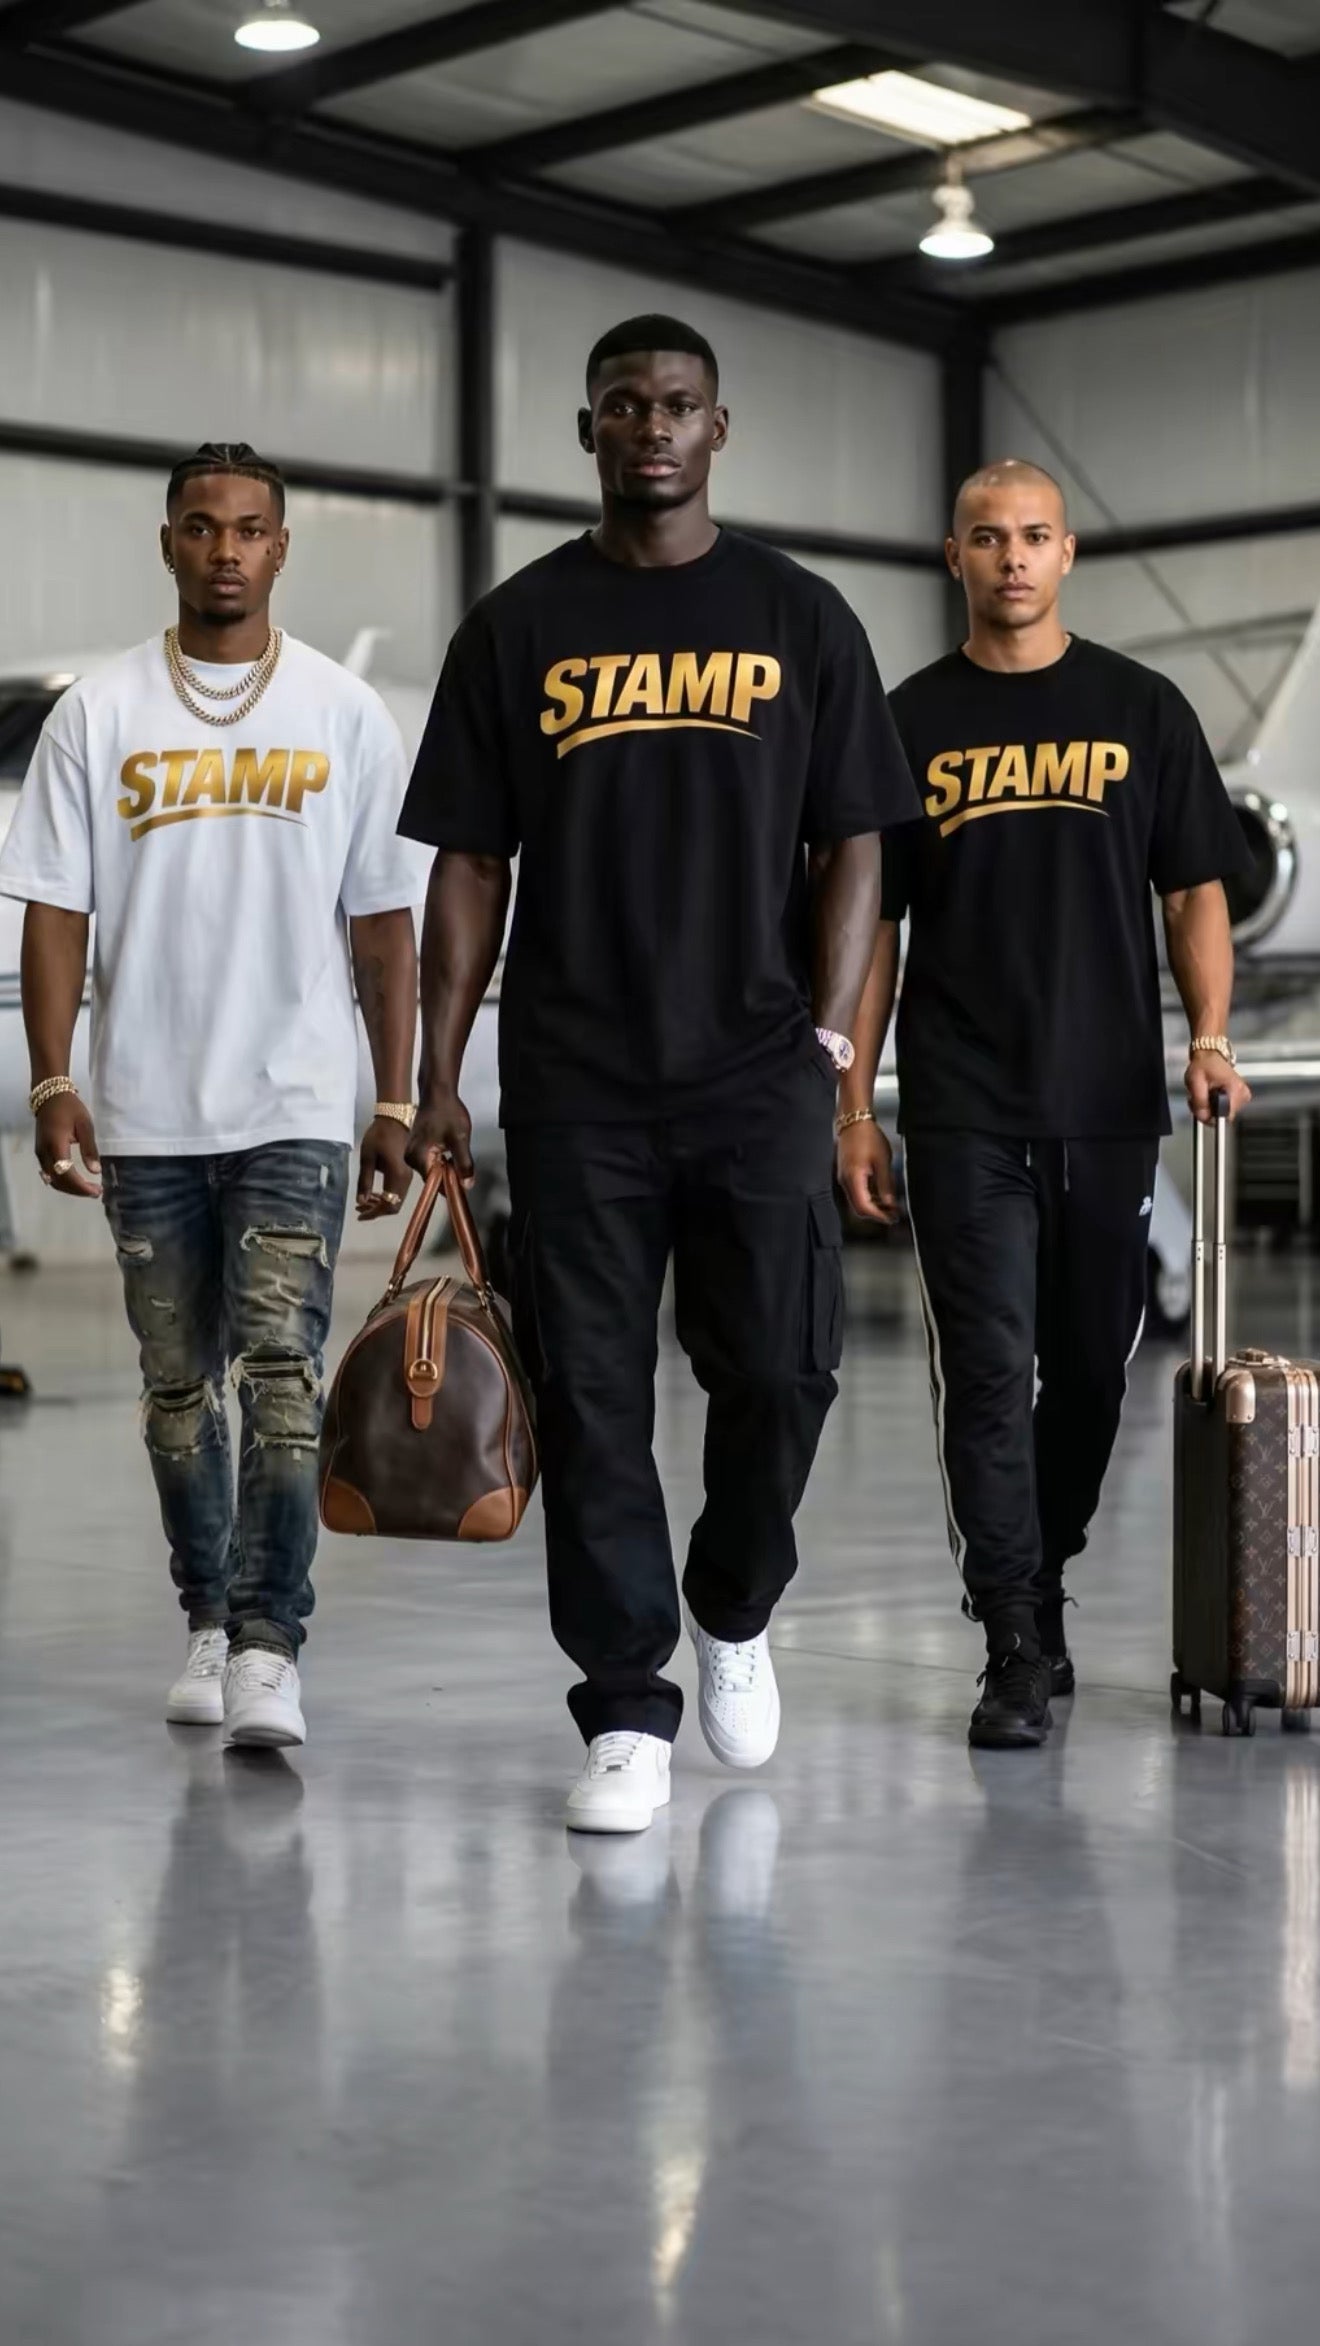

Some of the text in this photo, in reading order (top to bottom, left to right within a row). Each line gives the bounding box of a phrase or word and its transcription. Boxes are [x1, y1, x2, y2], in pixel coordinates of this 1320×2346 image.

[540, 651, 783, 735] STAMP
[117, 748, 330, 820] STAMP
[924, 741, 1130, 817] STAMP
